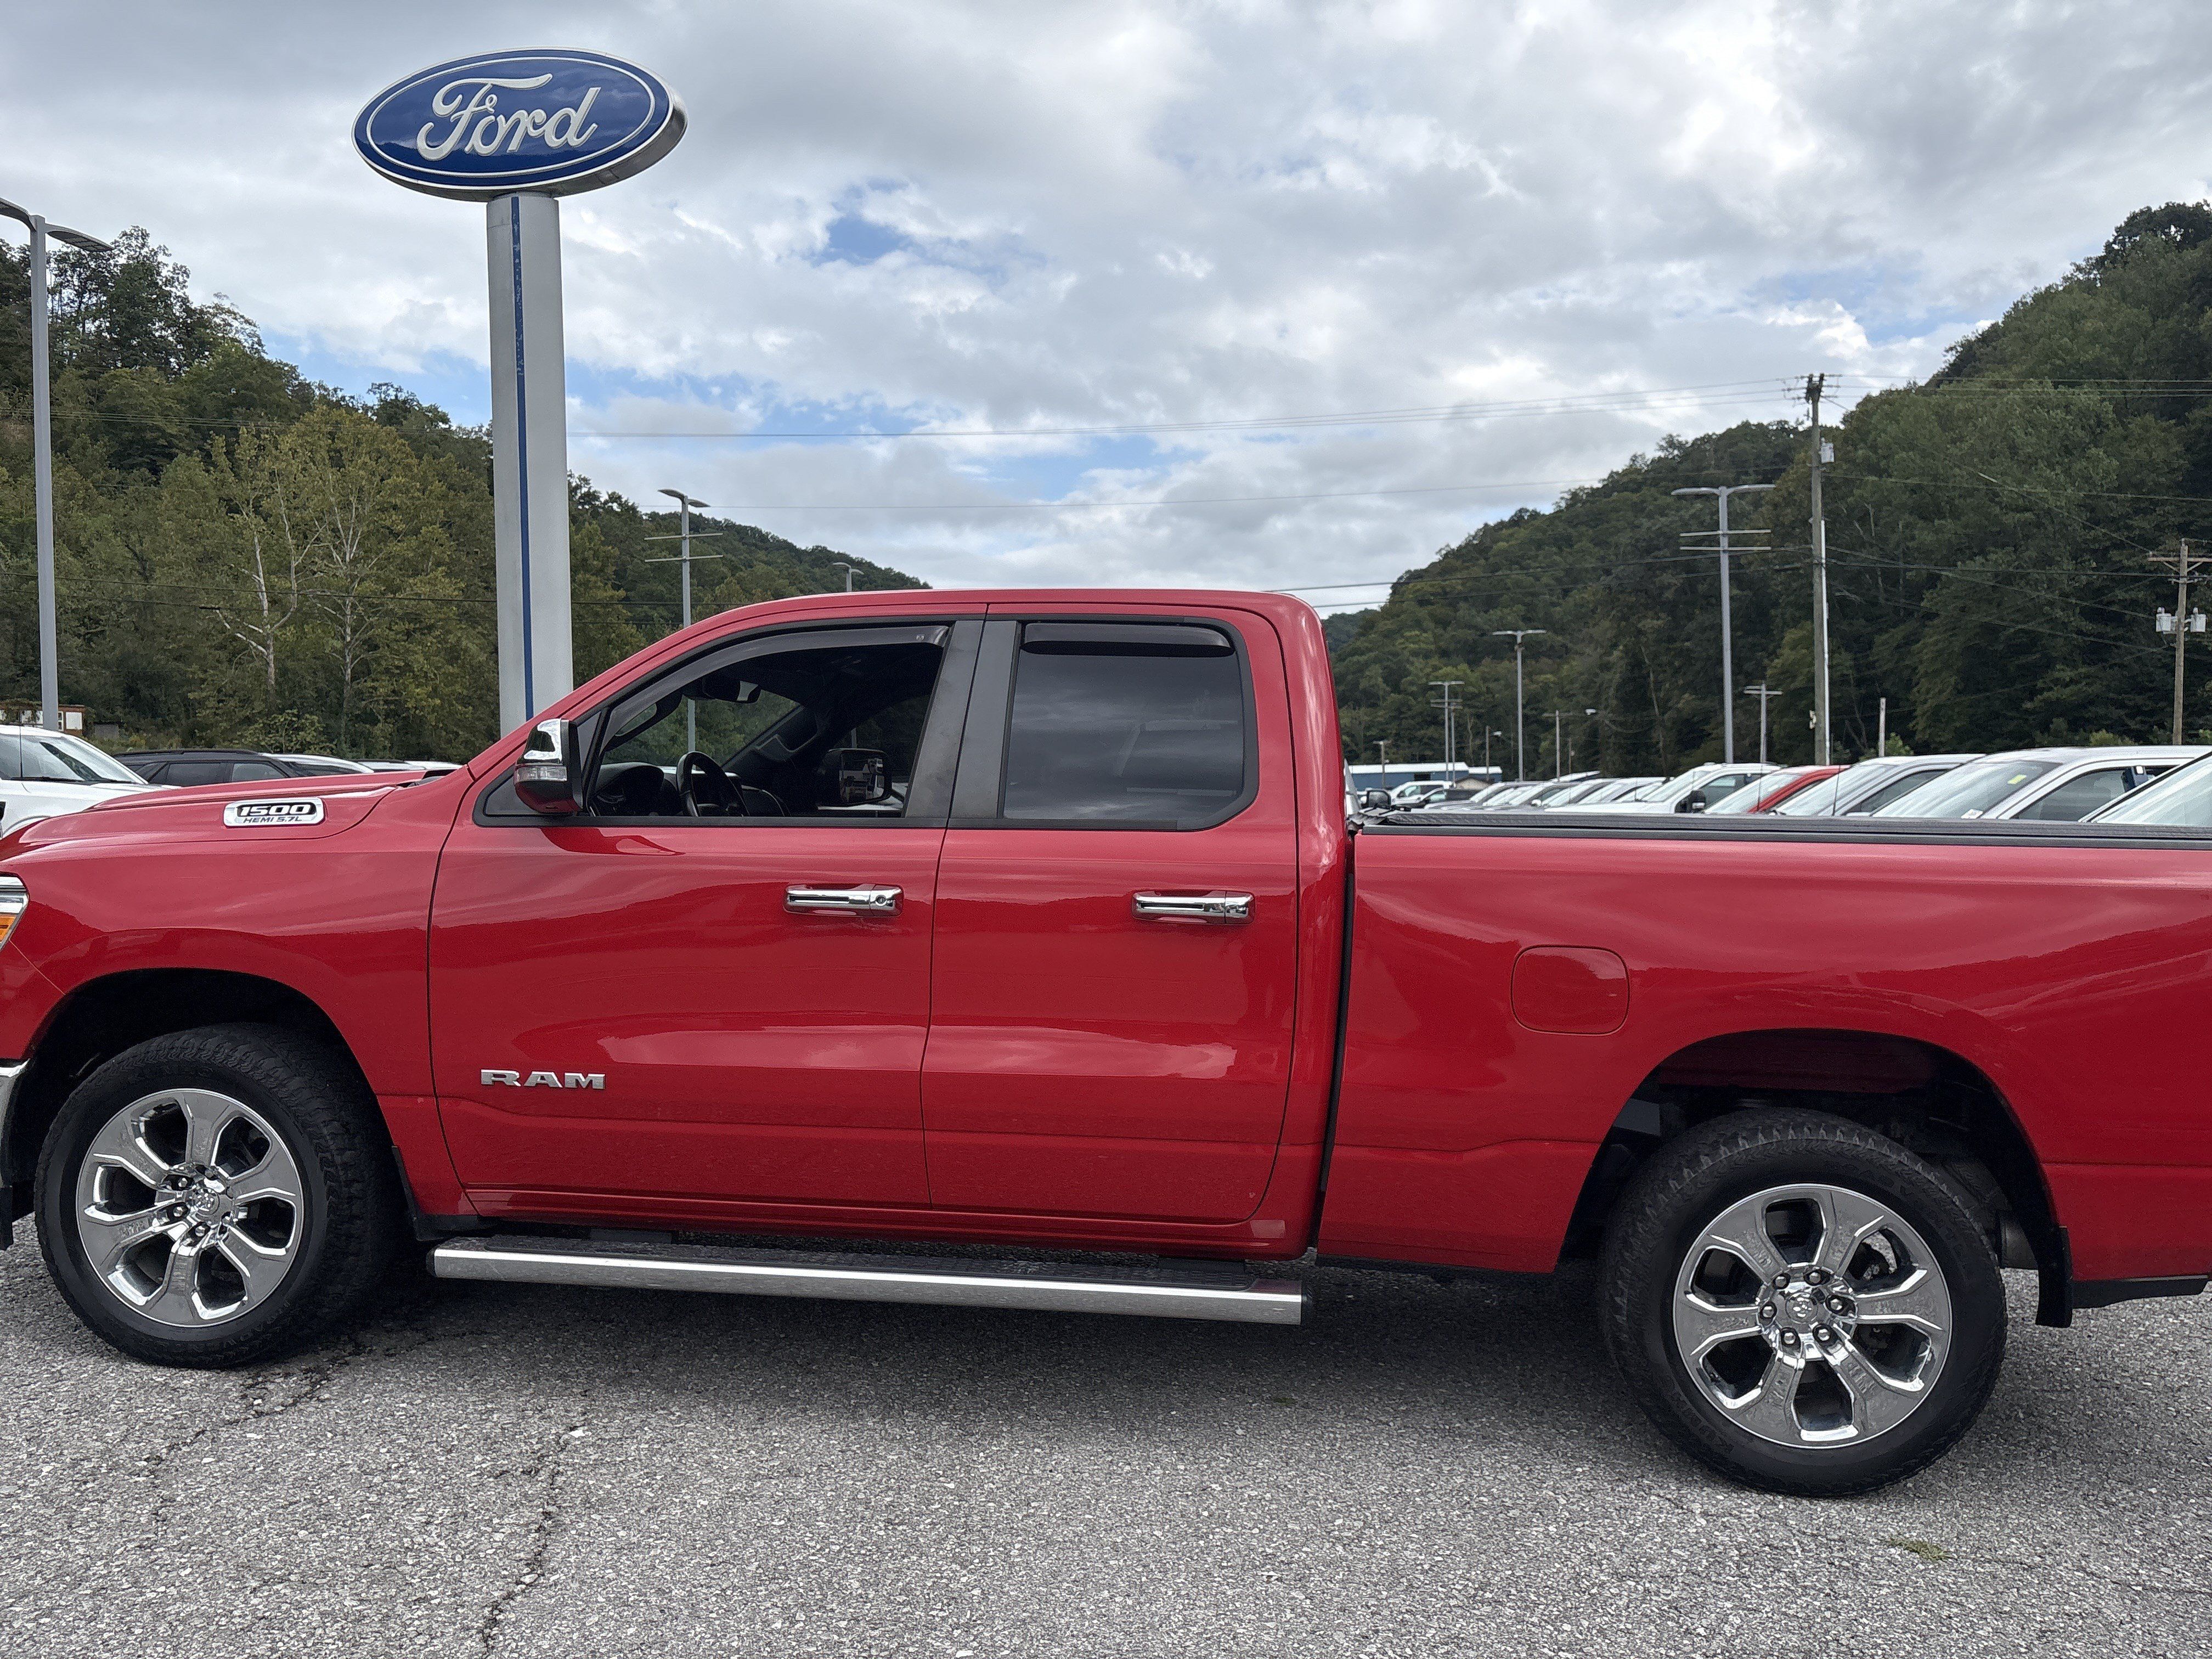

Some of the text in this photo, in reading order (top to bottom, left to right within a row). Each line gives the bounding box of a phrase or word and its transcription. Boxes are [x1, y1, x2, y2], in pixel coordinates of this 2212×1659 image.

[417, 74, 601, 160] Ford
[239, 804, 311, 816] 1500
[481, 1069, 606, 1090] RAM
